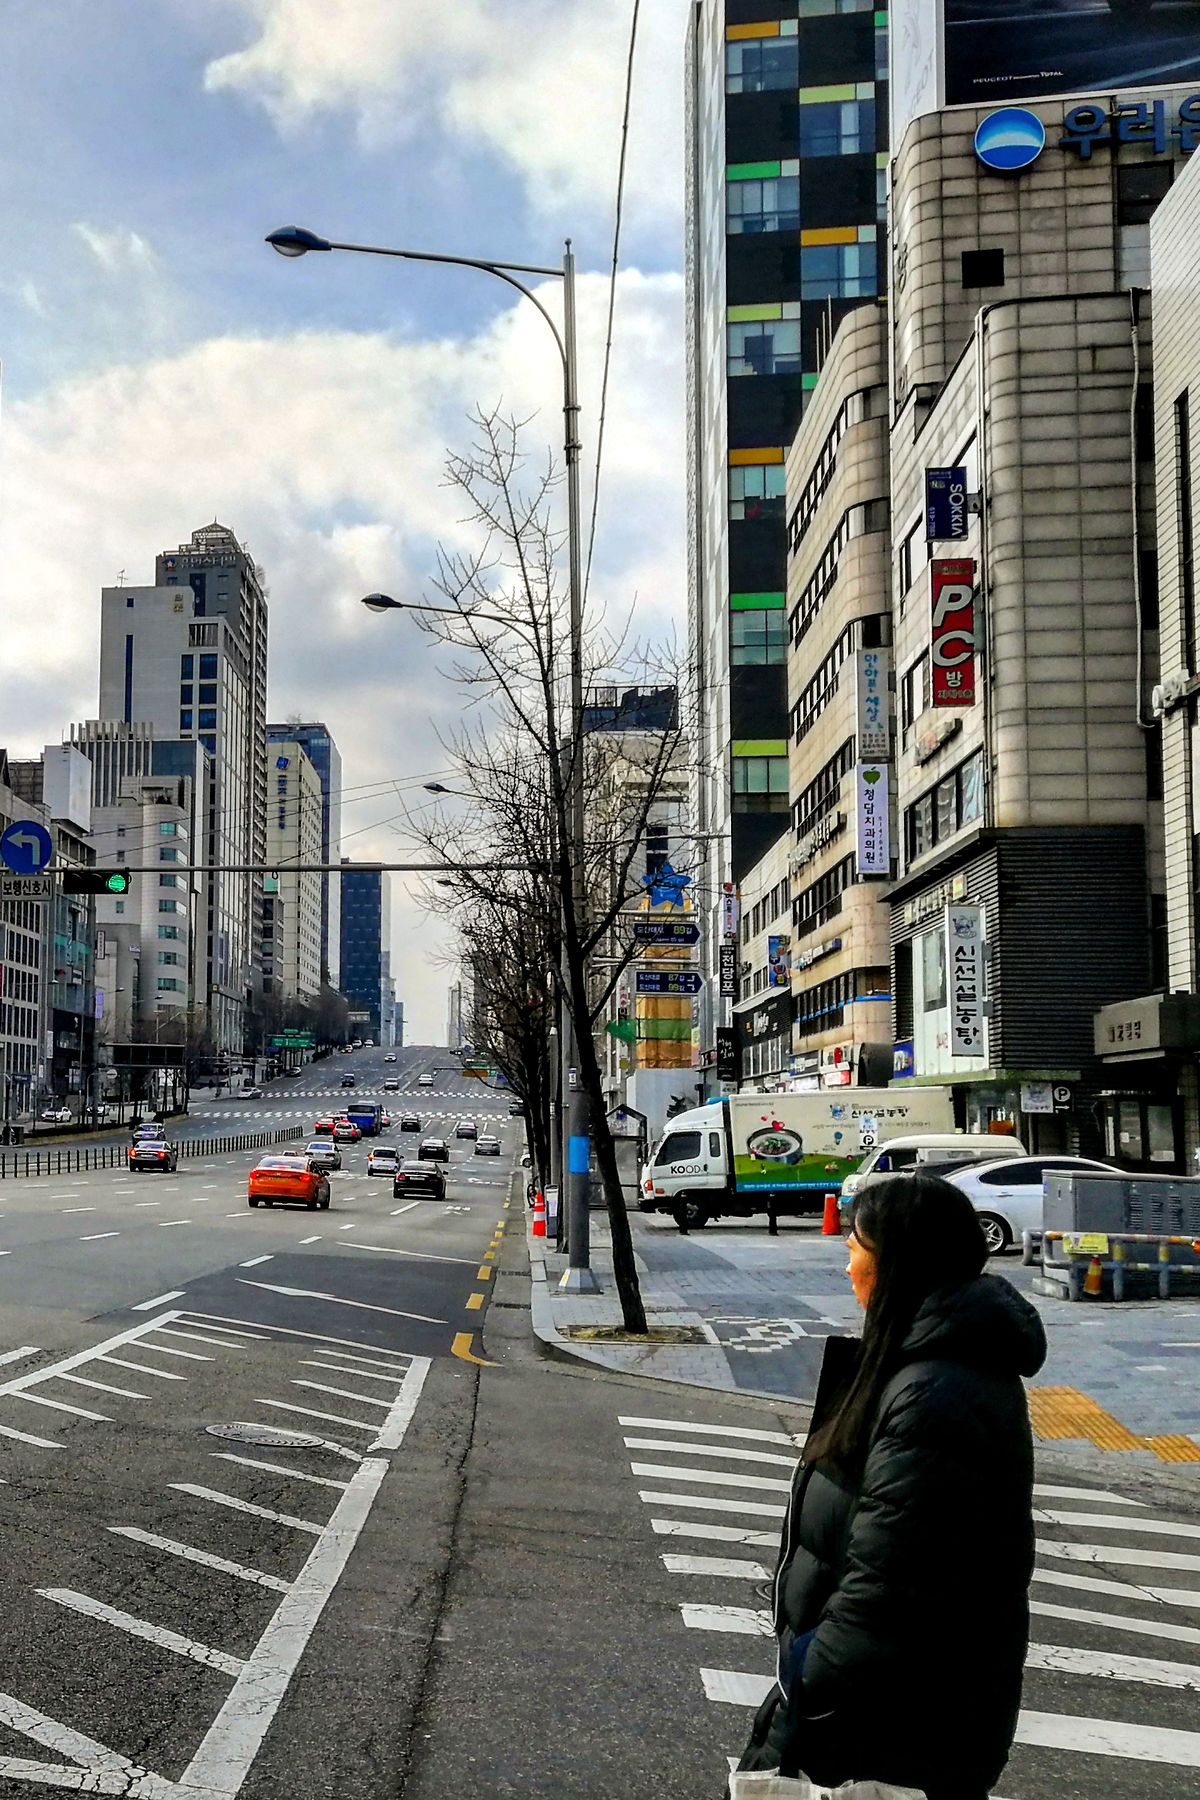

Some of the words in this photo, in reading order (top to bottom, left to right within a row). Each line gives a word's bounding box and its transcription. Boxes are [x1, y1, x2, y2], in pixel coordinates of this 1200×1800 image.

[864, 788, 875, 864] 청담치과의원
[3, 879, 50, 896] 보행신호시
[721, 955, 735, 992] 전당포
[954, 945, 980, 1046] 신선설농탕
